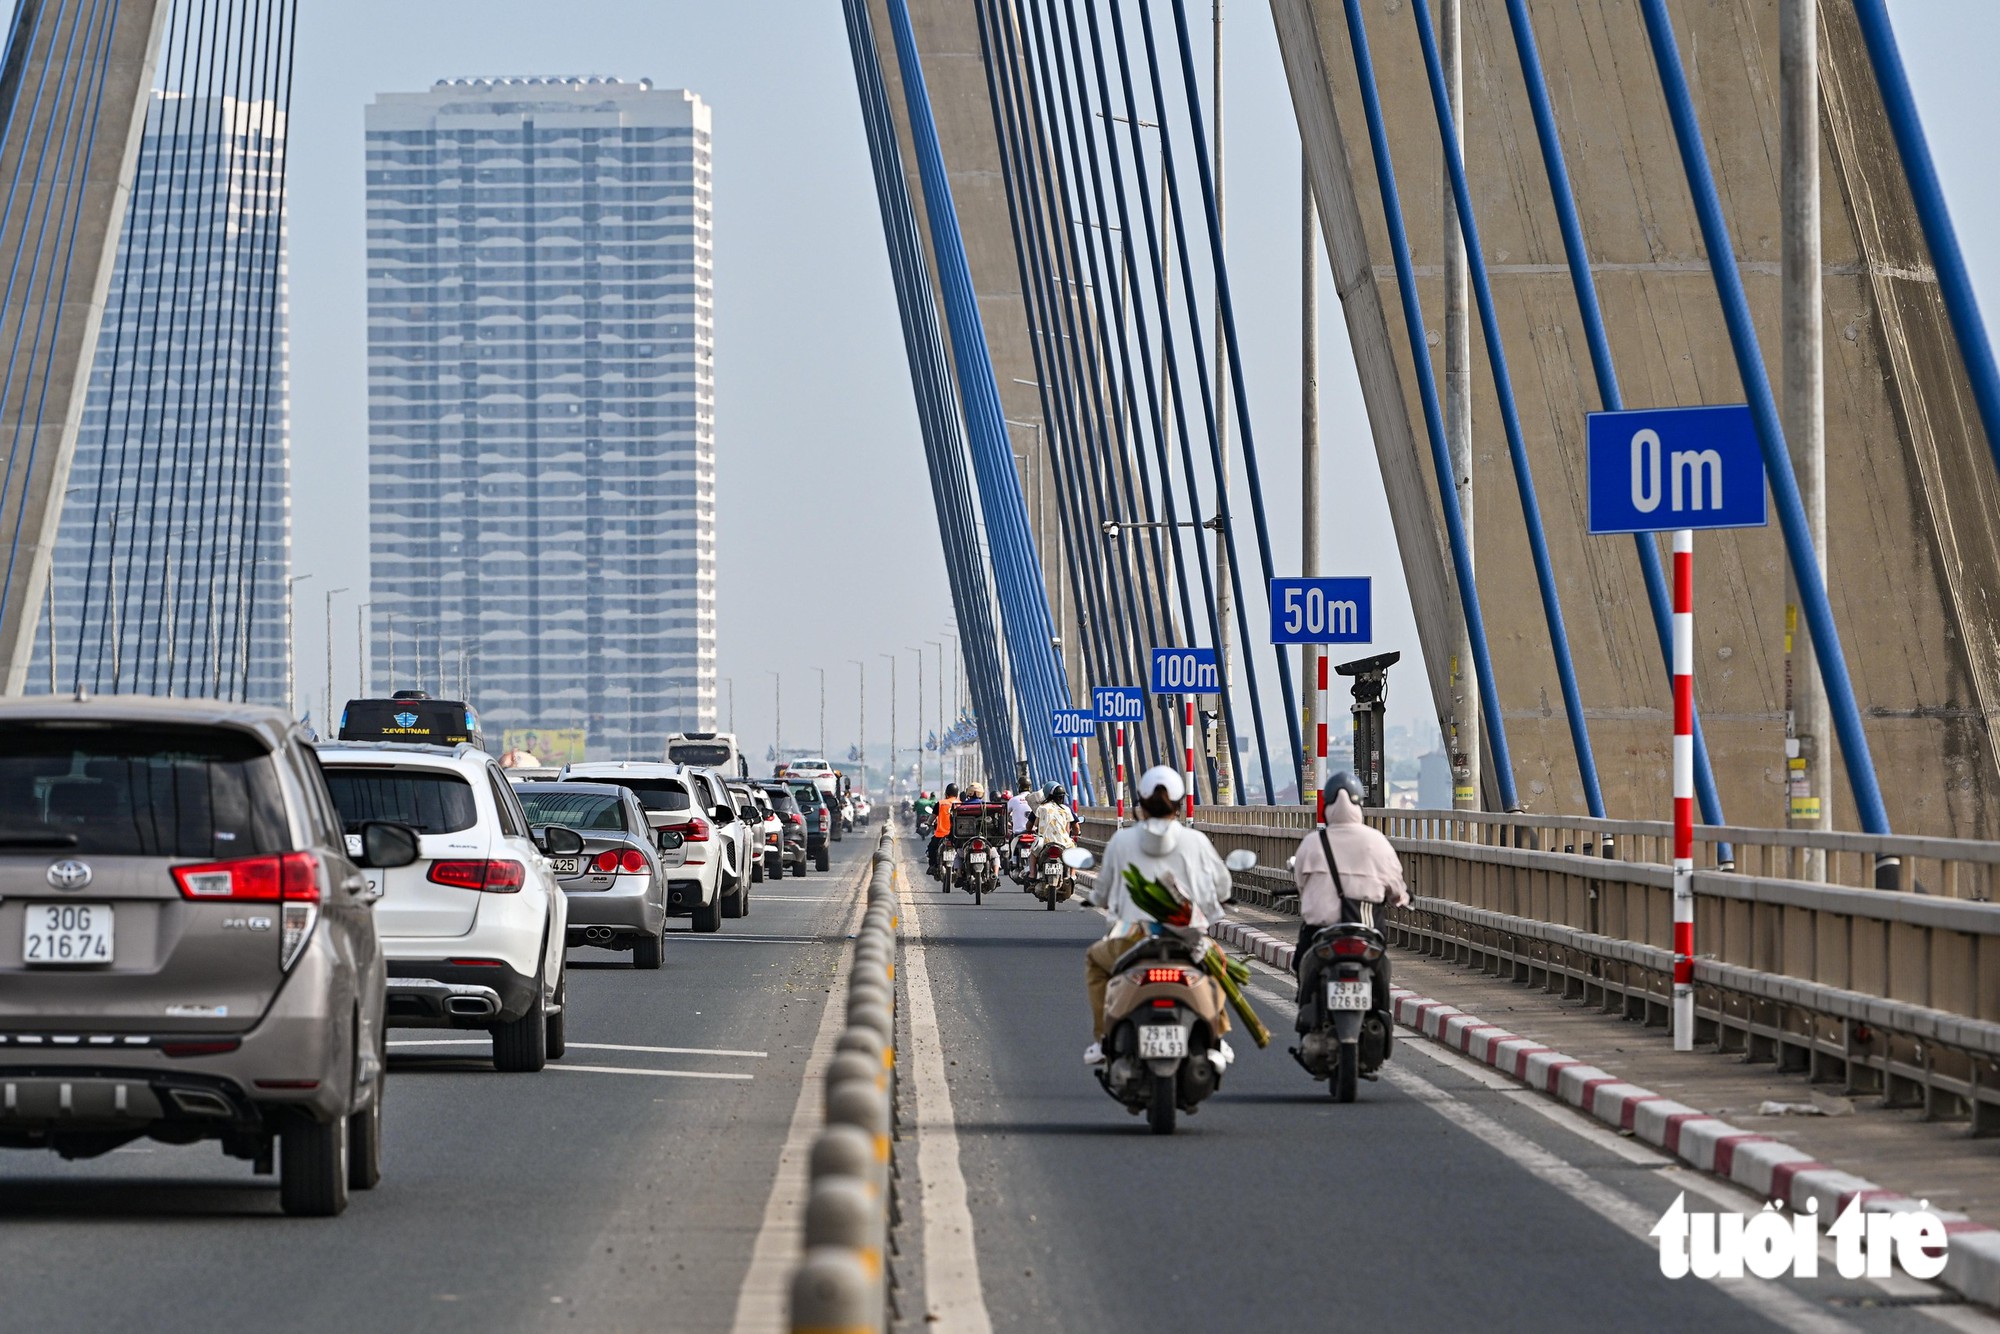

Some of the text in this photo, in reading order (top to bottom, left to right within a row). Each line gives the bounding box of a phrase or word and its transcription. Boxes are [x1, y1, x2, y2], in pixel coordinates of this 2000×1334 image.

[1630, 428, 1723, 513] 0m
[1283, 587, 1358, 634] 50m
[1156, 654, 1219, 688] 100m
[1095, 691, 1141, 718] 150m
[1053, 713, 1094, 735] 200m
[550, 859, 575, 871] 425
[46, 906, 91, 931] 30G
